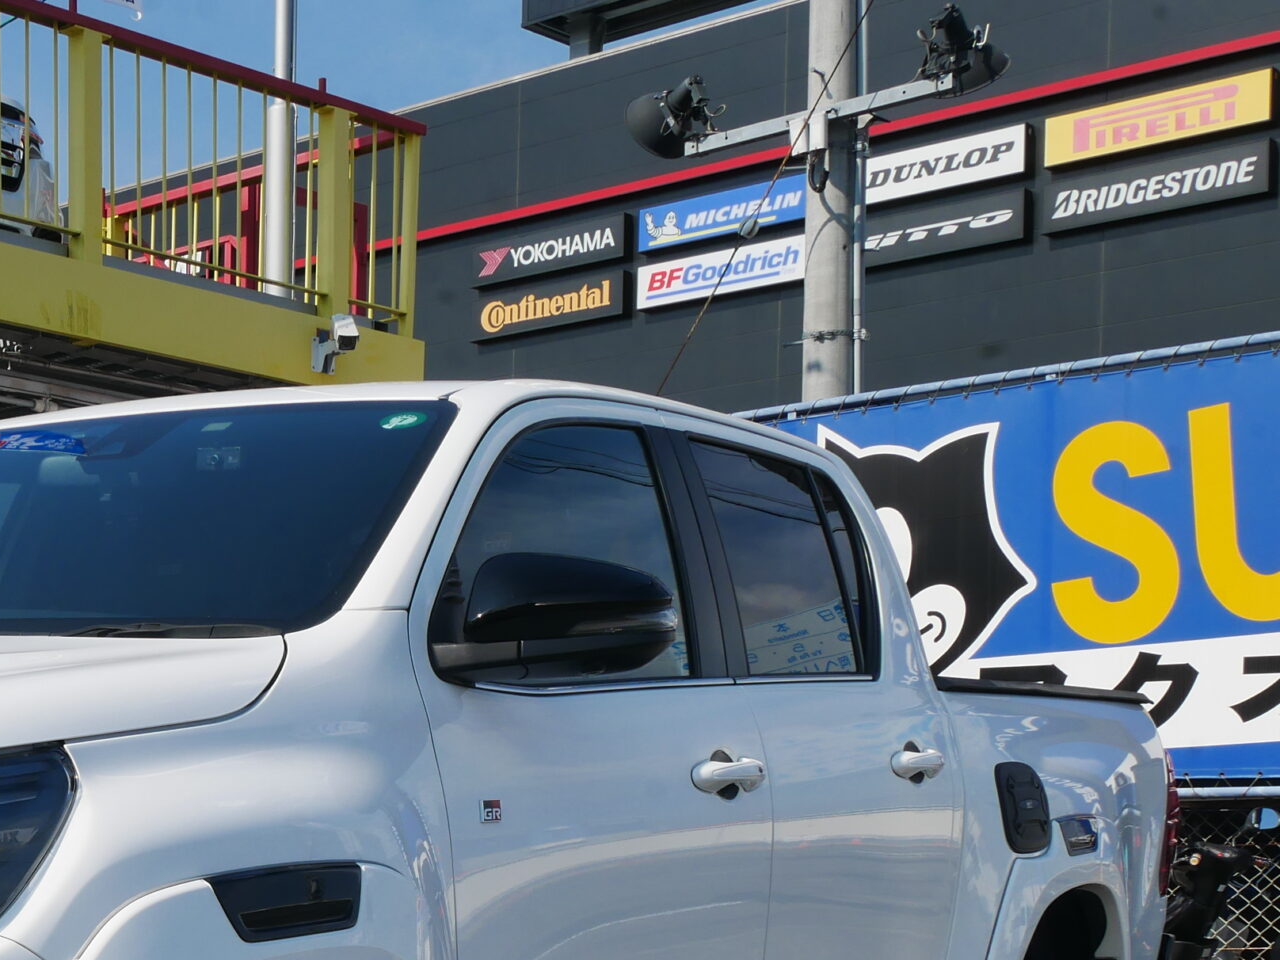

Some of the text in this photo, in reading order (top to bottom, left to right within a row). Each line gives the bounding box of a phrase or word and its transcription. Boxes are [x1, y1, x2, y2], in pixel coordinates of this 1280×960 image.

[1072, 83, 1240, 154] PIRELLI
[866, 140, 1015, 190] DUNLOP
[1051, 155, 1258, 220] BRIDGESTONE
[684, 190, 802, 230] MICHELIN
[510, 227, 616, 268] YOKOHAMA
[647, 245, 800, 293] BFGoodrich
[480, 279, 611, 333] Continental
[484, 808, 501, 820] GR
